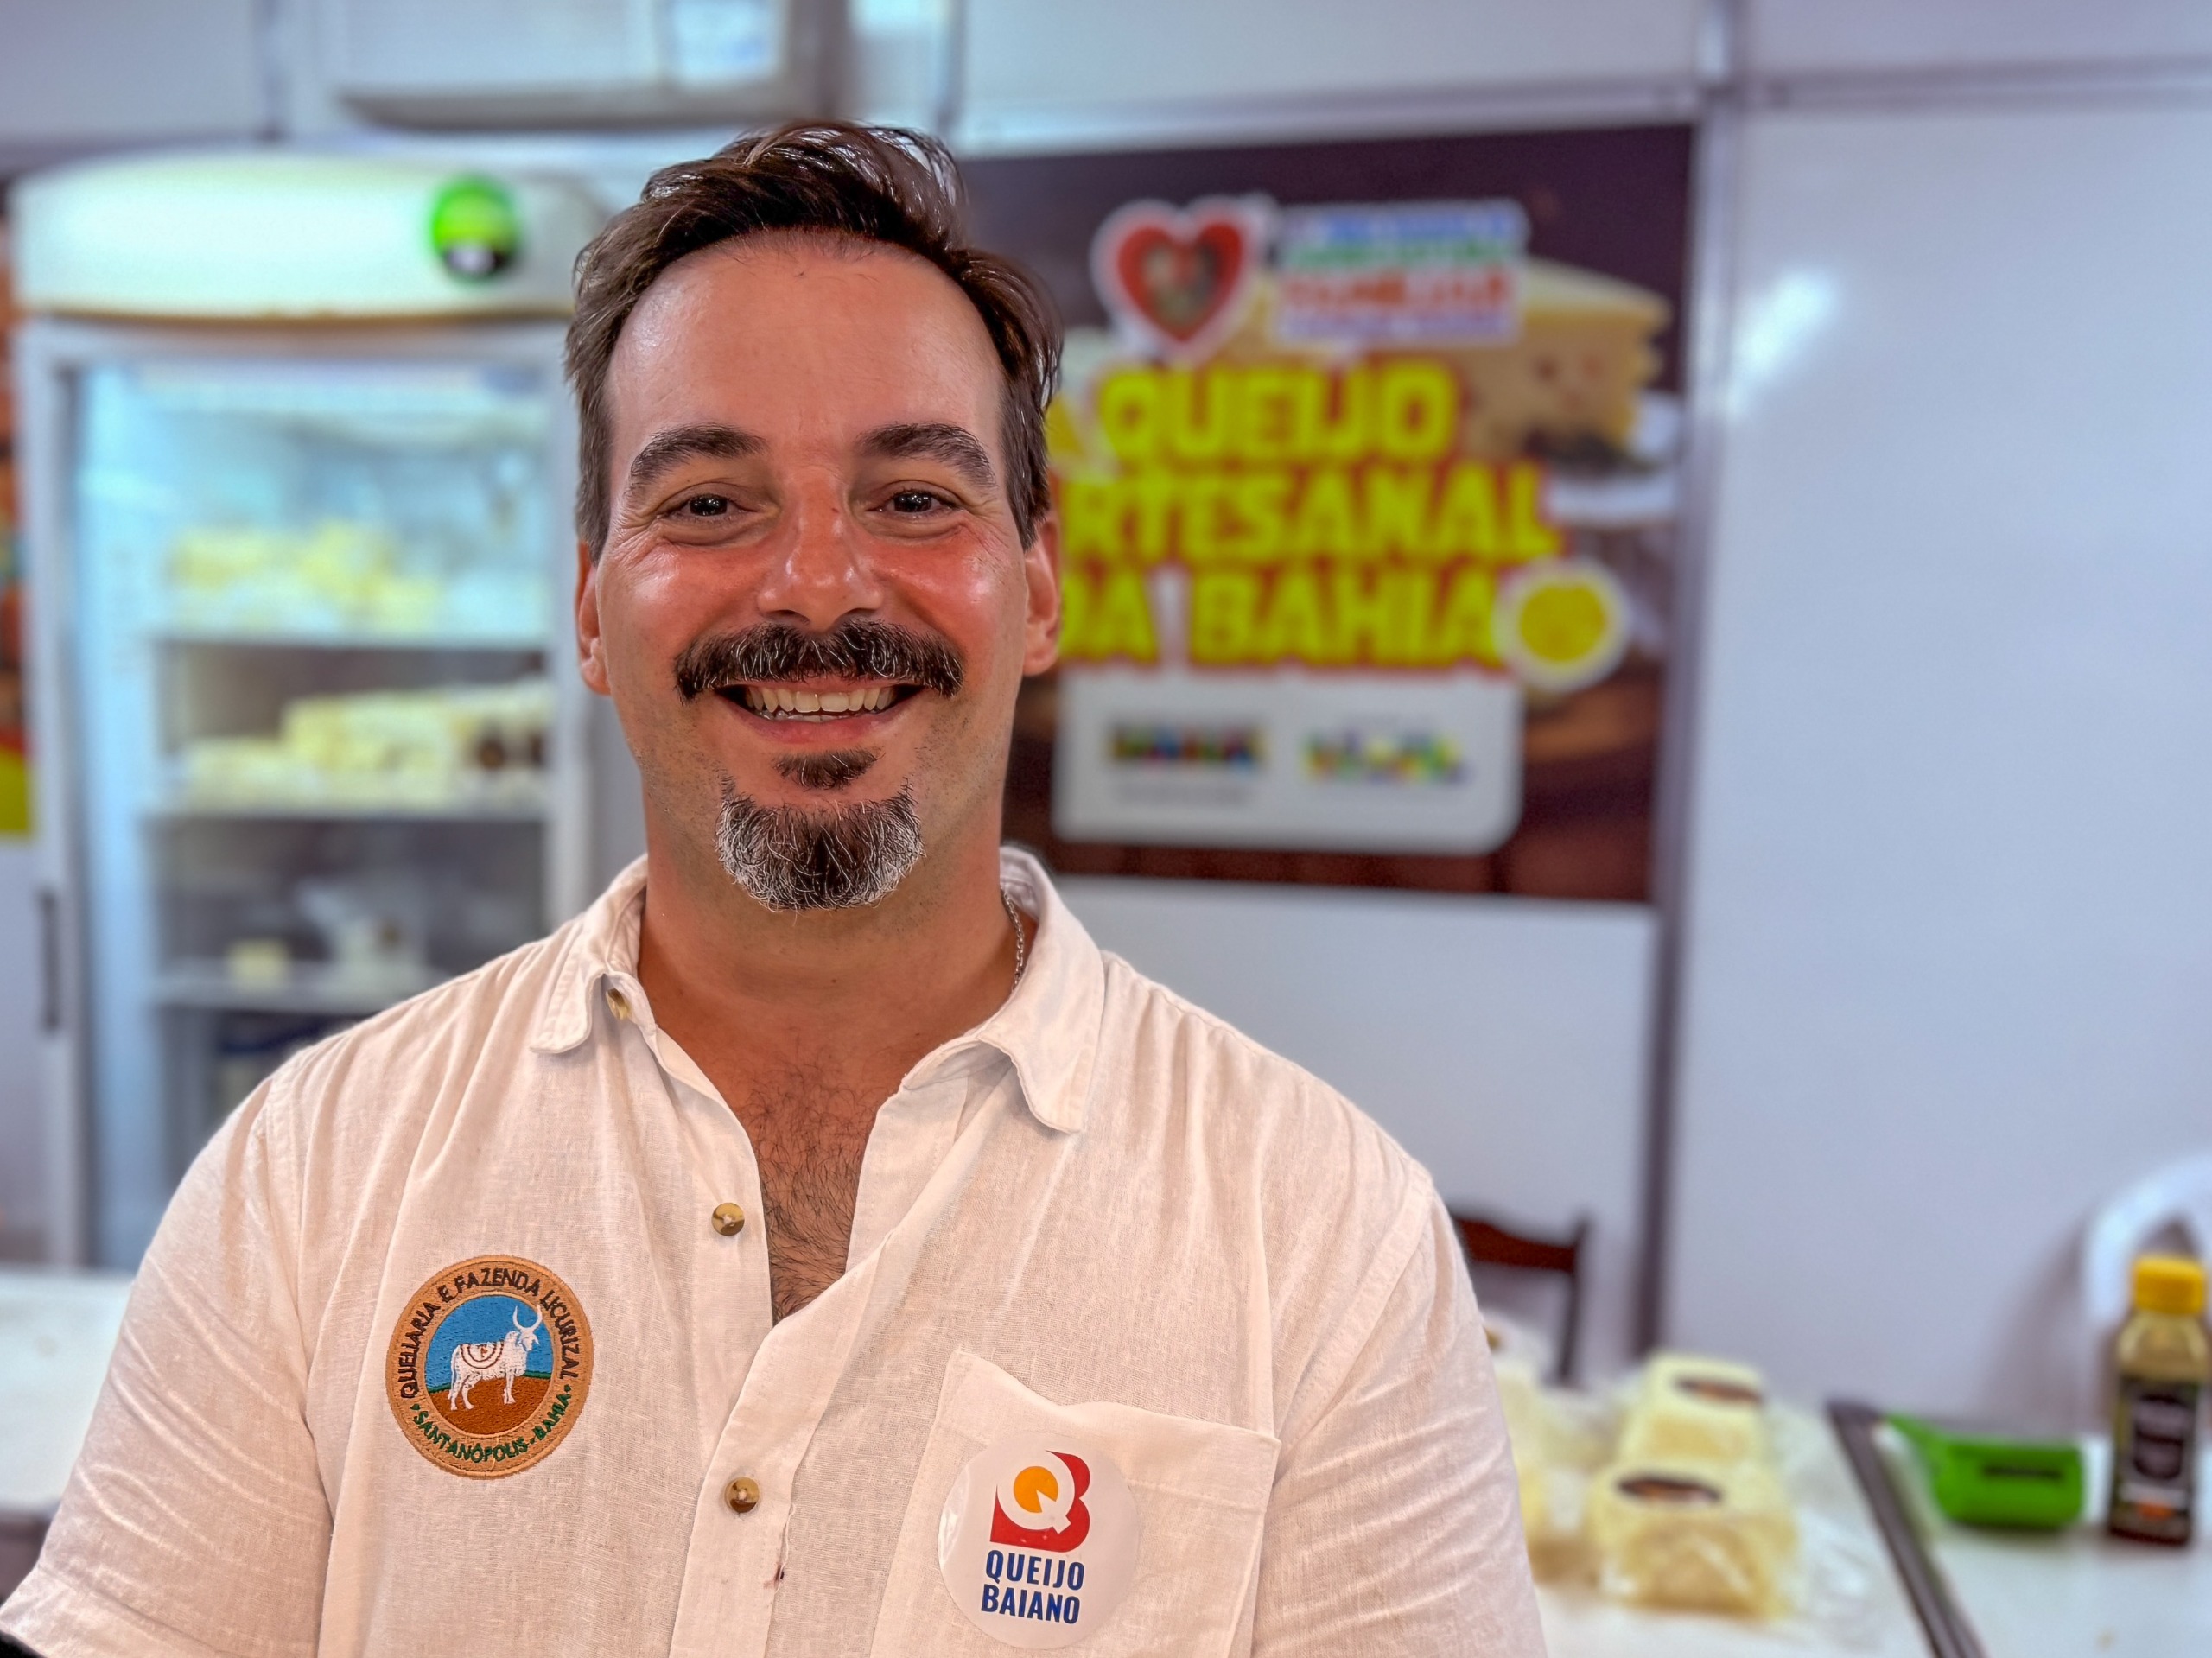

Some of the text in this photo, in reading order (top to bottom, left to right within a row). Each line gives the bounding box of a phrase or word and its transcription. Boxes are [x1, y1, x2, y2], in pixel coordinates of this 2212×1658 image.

[1096, 361, 1456, 461] QUEIJO
[1065, 463, 1559, 562] RTESANAL
[1191, 565, 1505, 664] BAHIA
[437, 1284, 454, 1303] E
[454, 1267, 541, 1297] FAZENDA
[540, 1290, 580, 1380] LICURIZAL
[981, 1584, 1080, 1624] BAIANO
[985, 1549, 1084, 1591] QUEIJO
